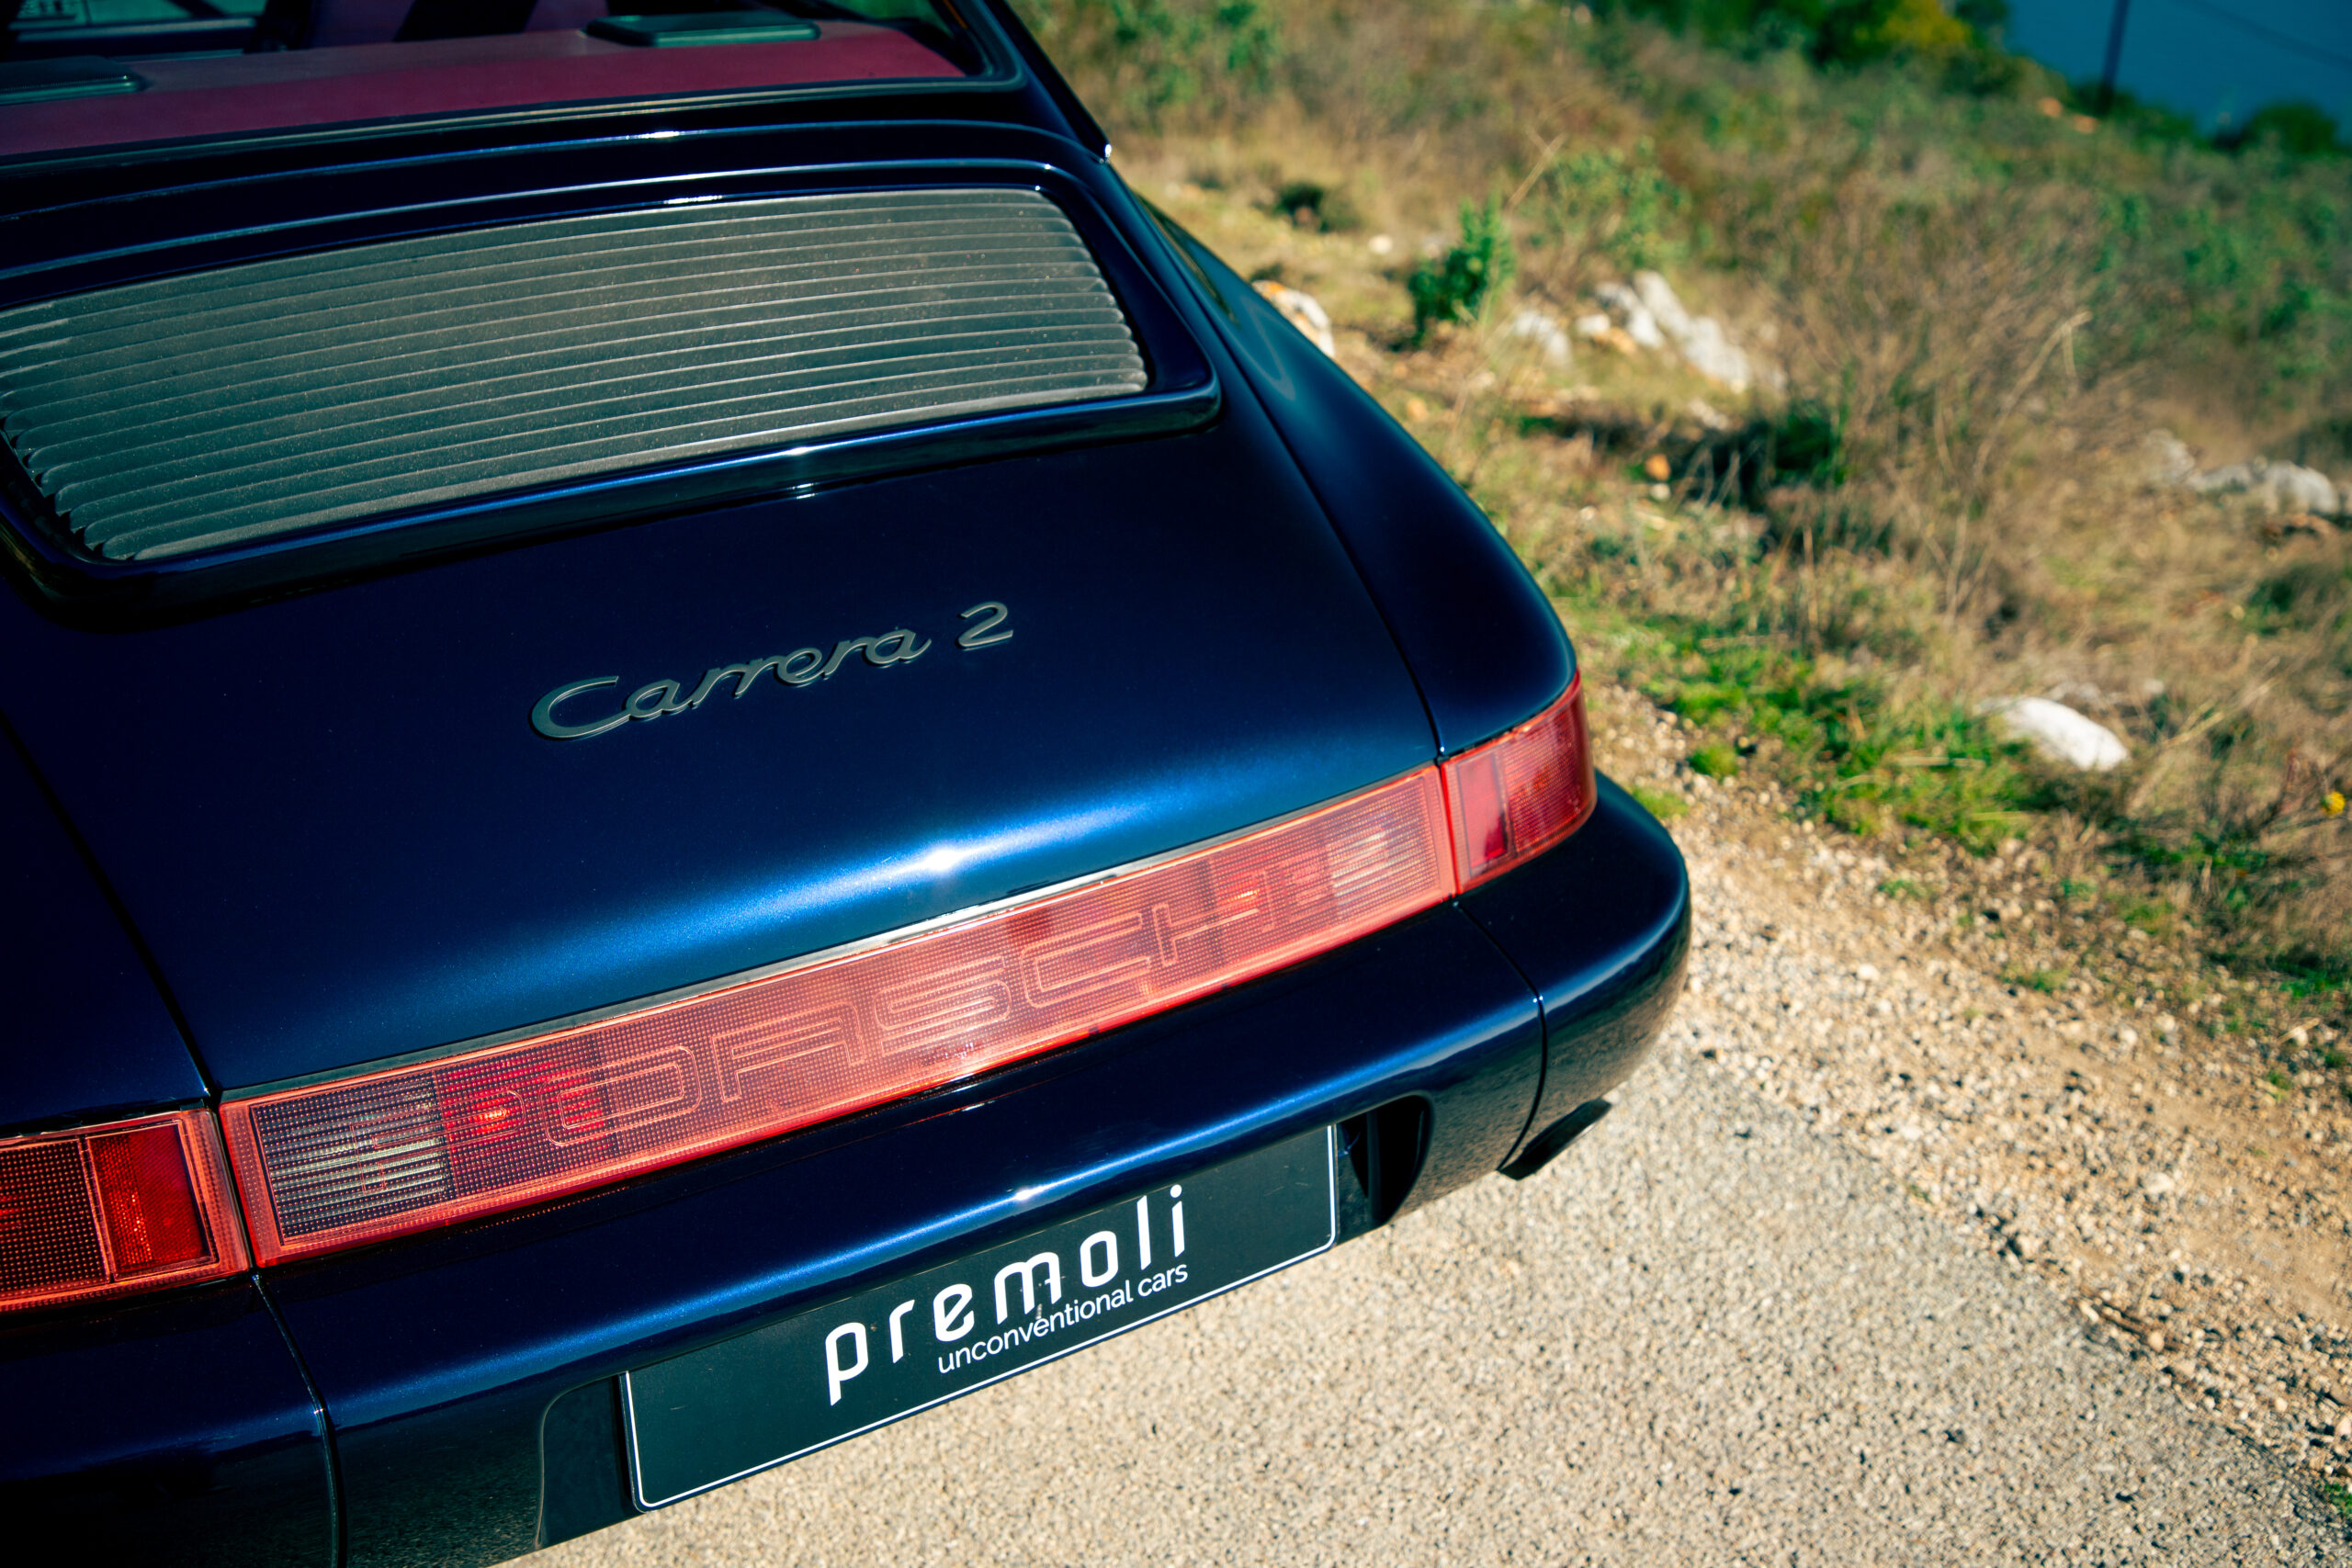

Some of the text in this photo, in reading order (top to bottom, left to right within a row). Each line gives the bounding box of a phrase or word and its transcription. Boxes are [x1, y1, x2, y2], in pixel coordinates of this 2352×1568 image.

[530, 601, 1014, 739] Carrera 2
[349, 822, 1393, 1195] PORSCHE
[825, 1184, 1186, 1406] premoli
[937, 1263, 1189, 1375] unconventional cars
